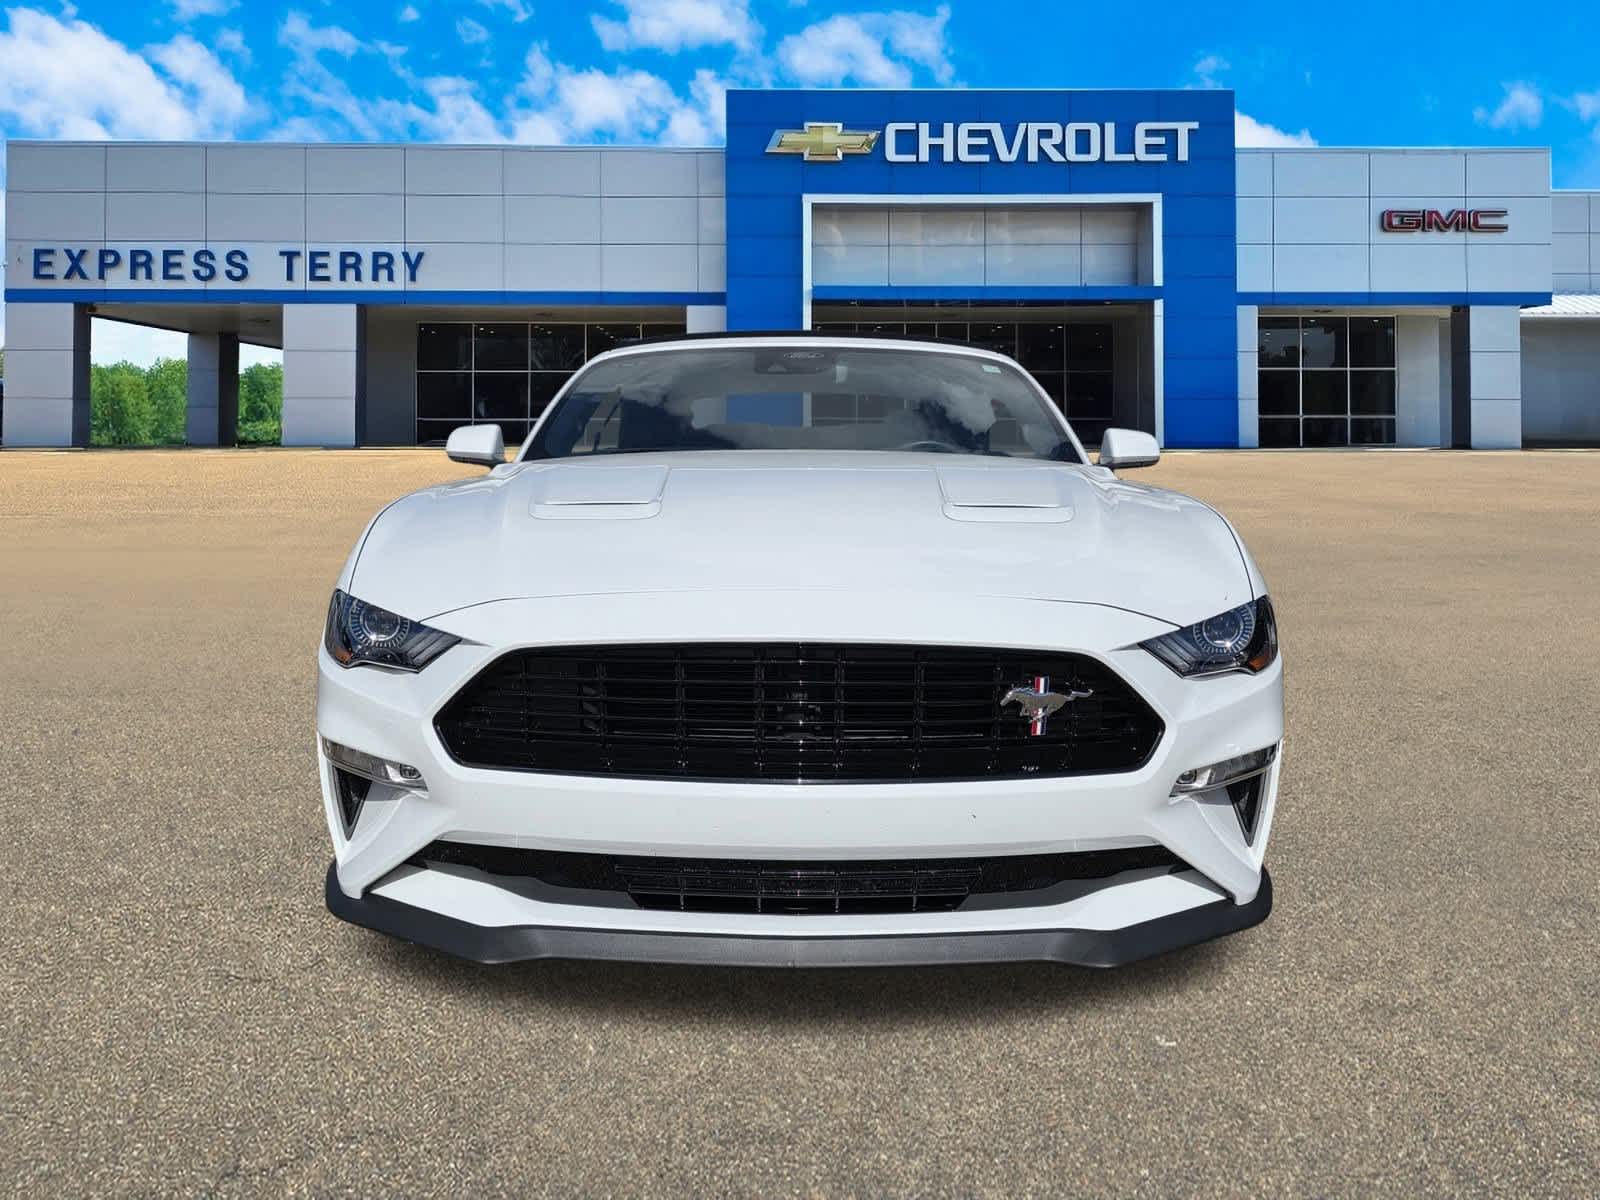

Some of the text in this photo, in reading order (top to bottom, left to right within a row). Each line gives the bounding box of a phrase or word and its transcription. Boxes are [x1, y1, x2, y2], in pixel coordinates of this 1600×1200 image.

[885, 121, 1199, 162] CHEVROLET
[1381, 209, 1508, 232] GMC
[33, 248, 425, 283] EXPRESS TERRY
